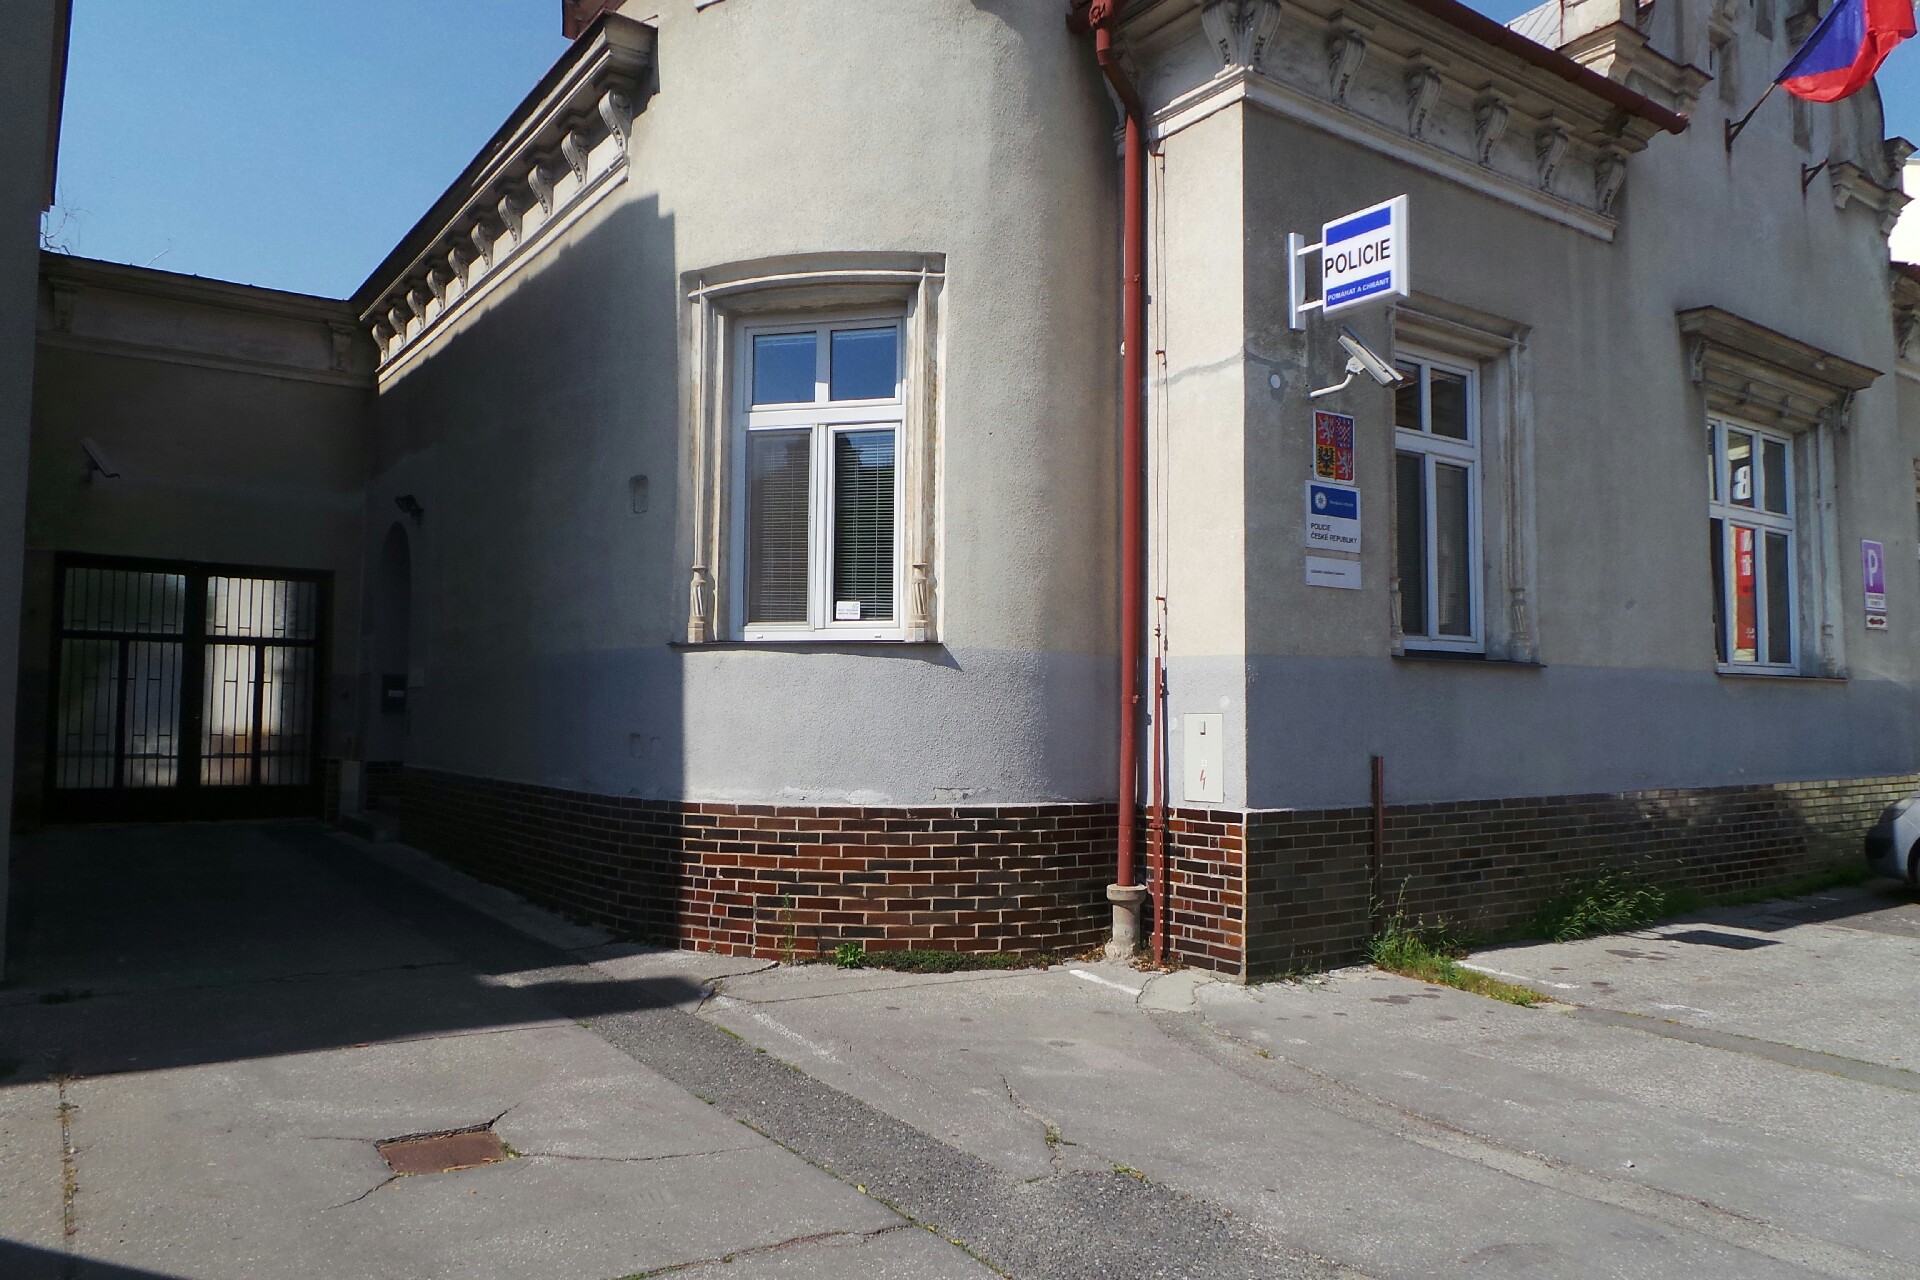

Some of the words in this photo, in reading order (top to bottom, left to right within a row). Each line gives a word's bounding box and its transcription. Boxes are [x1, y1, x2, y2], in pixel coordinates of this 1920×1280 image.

[1325, 238, 1391, 278] POLICIE
[1311, 523, 1331, 531] POLICIE
[1868, 549, 1879, 587] P
